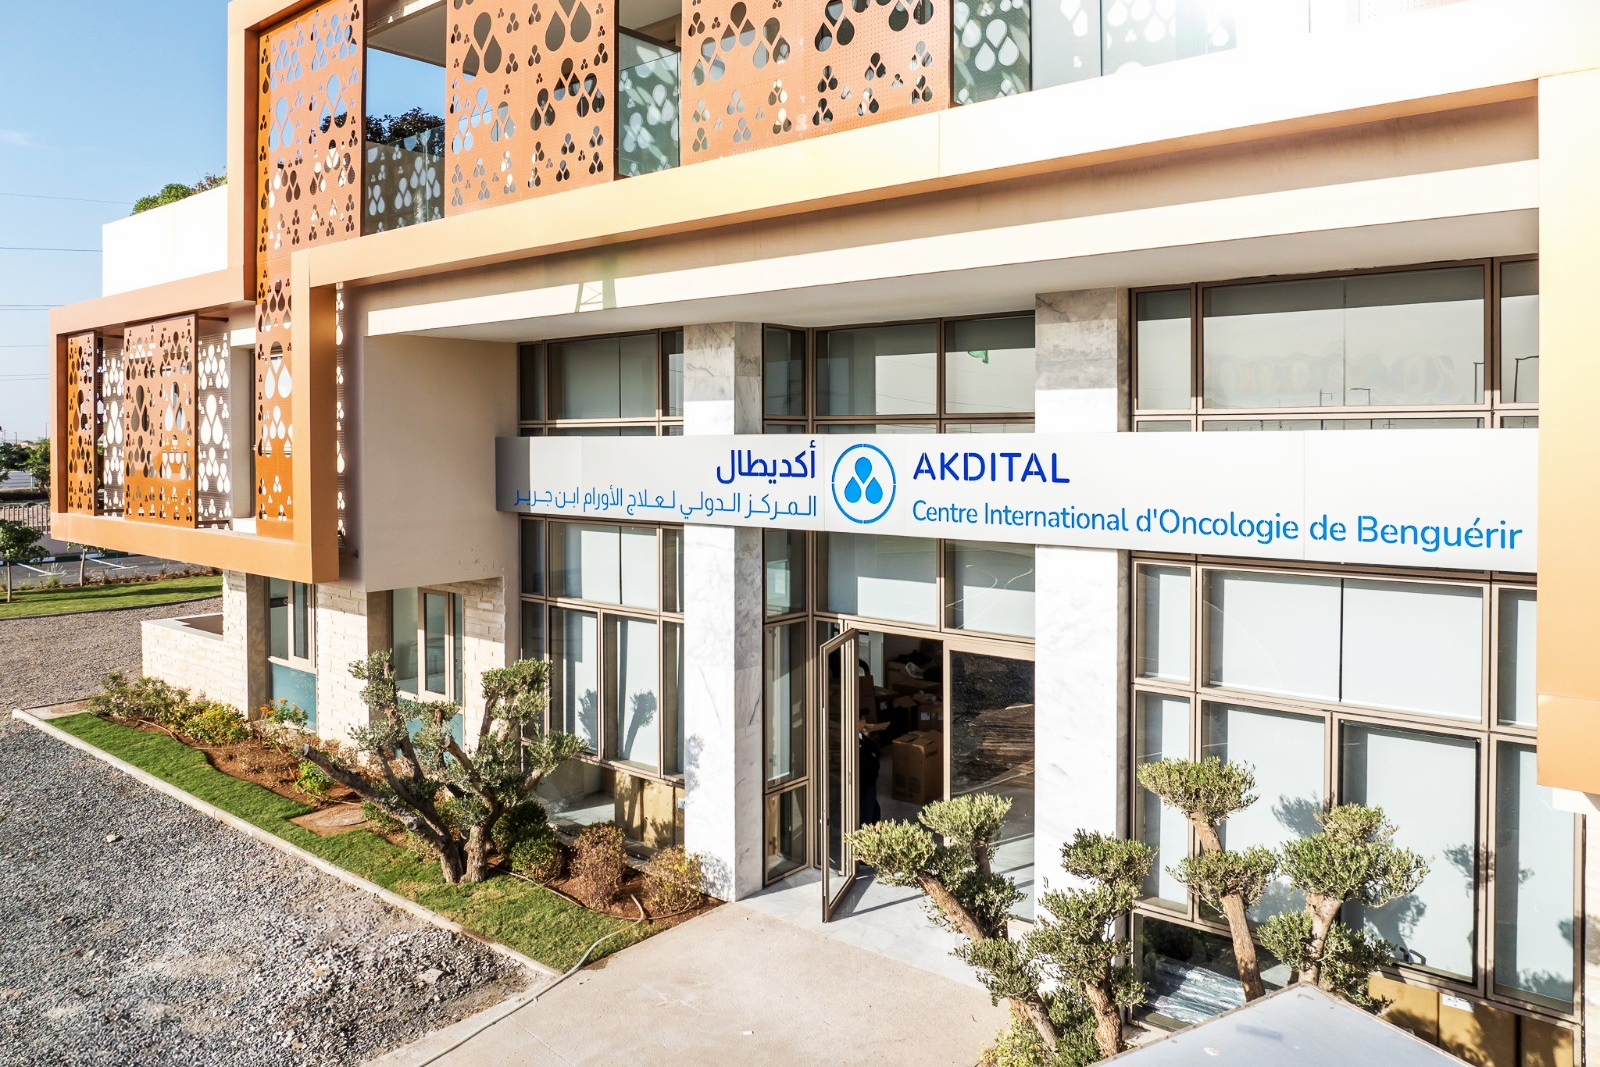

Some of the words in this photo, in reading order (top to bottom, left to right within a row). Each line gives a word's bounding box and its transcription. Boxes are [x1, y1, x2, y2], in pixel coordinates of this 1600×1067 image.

[716, 439, 816, 485] أكديطال
[912, 451, 1071, 484] AKDITAL
[513, 489, 553, 507] جرير
[554, 486, 579, 508] ابن
[583, 484, 623, 512] الأورام
[626, 489, 676, 516] لعلاج
[679, 491, 741, 519] الدولي
[744, 493, 817, 520] المركز
[912, 499, 979, 524] Centre
[984, 502, 1130, 532] International
[1135, 508, 1300, 546] d'Oncologie
[1309, 513, 1347, 542] de
[1357, 514, 1524, 554] Benguérir
